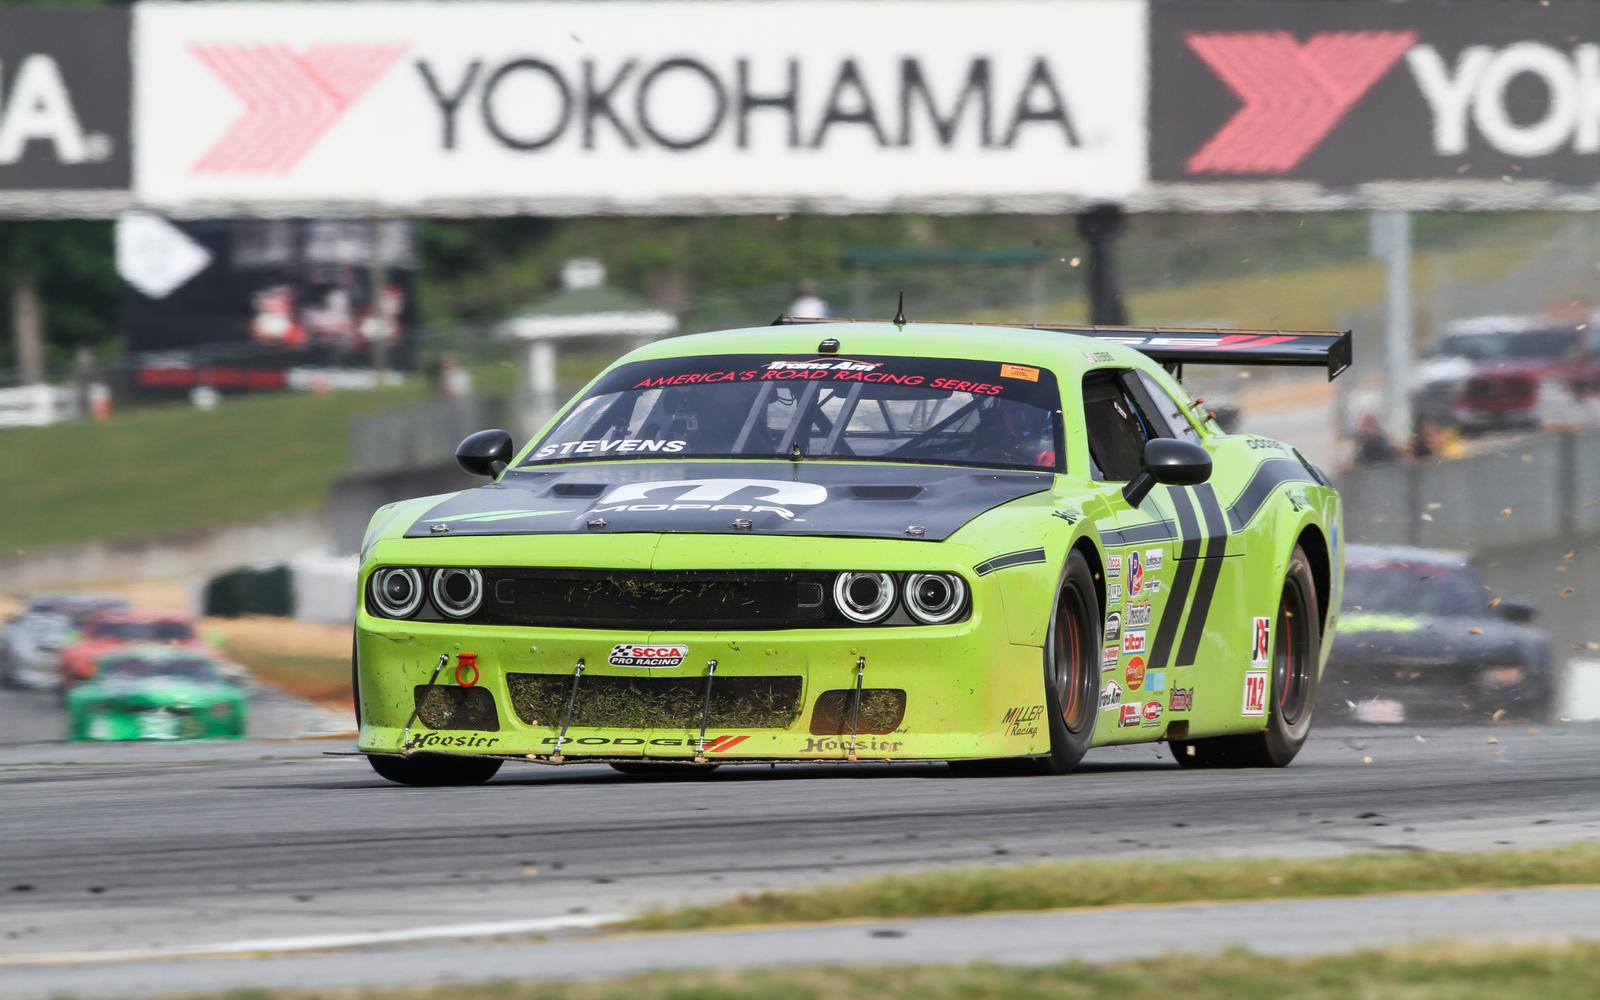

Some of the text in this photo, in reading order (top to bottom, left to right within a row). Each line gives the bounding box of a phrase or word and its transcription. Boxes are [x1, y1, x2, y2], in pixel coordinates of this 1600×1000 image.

[414, 58, 1080, 151] YOKOHAMA
[766, 360, 876, 371] Trans Am
[633, 370, 1003, 395] AMERICA'S ROAD RACING SERIES
[536, 439, 687, 457] STEVENS
[631, 647, 682, 657] SCCA
[611, 657, 680, 666] PRO RACING
[1246, 677, 1264, 710] TA2
[1001, 705, 1044, 723] MILLER
[1010, 722, 1040, 738] Racing
[411, 732, 500, 748] Hoosier
[541, 737, 717, 746] DODGE
[800, 737, 904, 752] Hoosier
